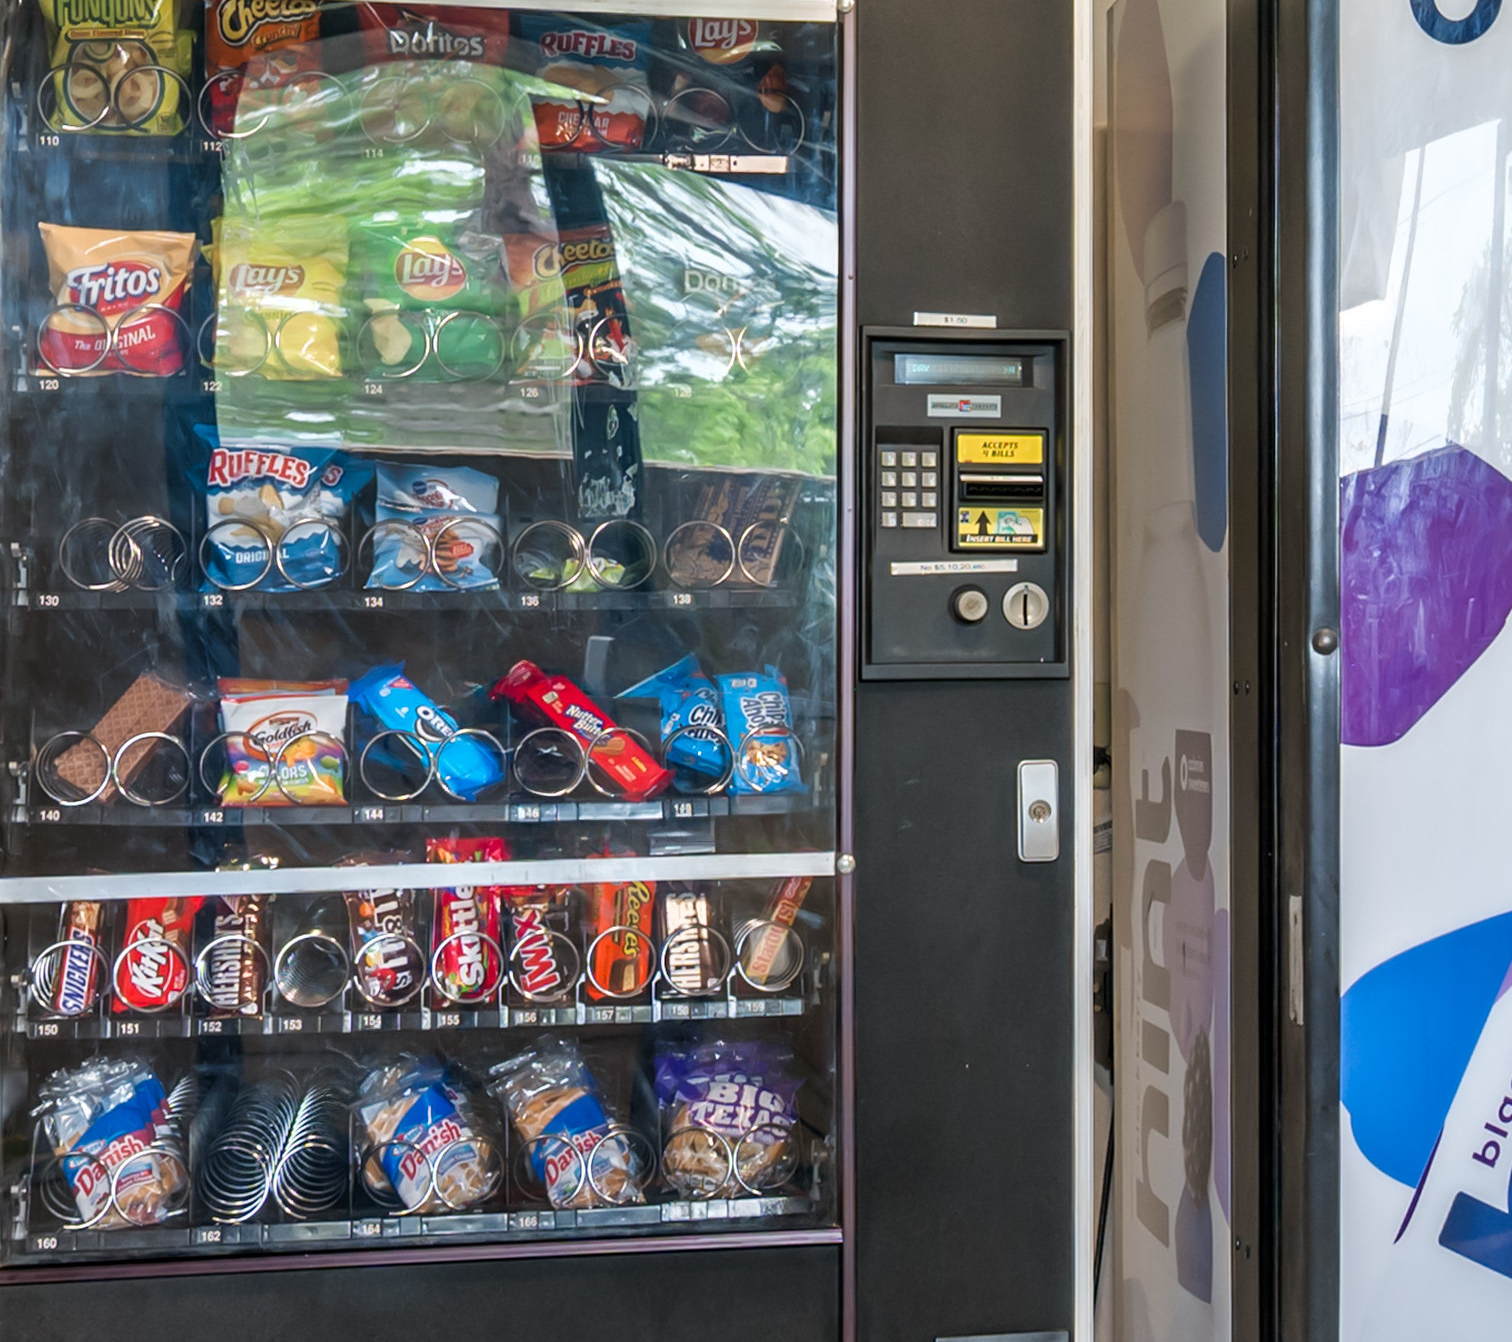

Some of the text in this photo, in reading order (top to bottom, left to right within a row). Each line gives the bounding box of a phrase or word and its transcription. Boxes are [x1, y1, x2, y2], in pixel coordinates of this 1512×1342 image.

[390, 23, 485, 56] Doritos
[540, 31, 636, 61] RUFFLES
[39, 135, 60, 147] 110
[203, 140, 223, 152] 112
[365, 148, 384, 159] 114
[67, 262, 161, 311] Fritos
[39, 380, 59, 391] 120
[203, 381, 223, 392] 122
[364, 384, 383, 395] 124
[208, 448, 310, 488] RUFFLES
[966, 534, 994, 543] INSERT
[995, 535, 1011, 543] BILL
[39, 595, 59, 606] 130
[203, 596, 223, 607] 132
[364, 597, 383, 608] 134
[254, 719, 312, 746] Goldfish
[40, 810, 60, 821] 140
[203, 812, 224, 823] 142
[364, 809, 384, 820] 144
[1135, 755, 1172, 1248] hint
[441, 1015, 460, 1026] 155
[596, 1011, 613, 1021] 157
[38, 1024, 58, 1036] 150
[121, 1023, 139, 1035] 151
[202, 1021, 222, 1033] 152
[284, 1020, 303, 1031] 153
[707, 1081, 785, 1113] BIG
[690, 1100, 790, 1138] TEXAS
[399, 1121, 462, 1181] Danish
[544, 1132, 604, 1187] Danish
[74, 1134, 145, 1198] Danish
[519, 1216, 538, 1228] 166
[362, 1223, 381, 1235] 164
[201, 1230, 221, 1242] 162
[37, 1237, 57, 1249] 160
